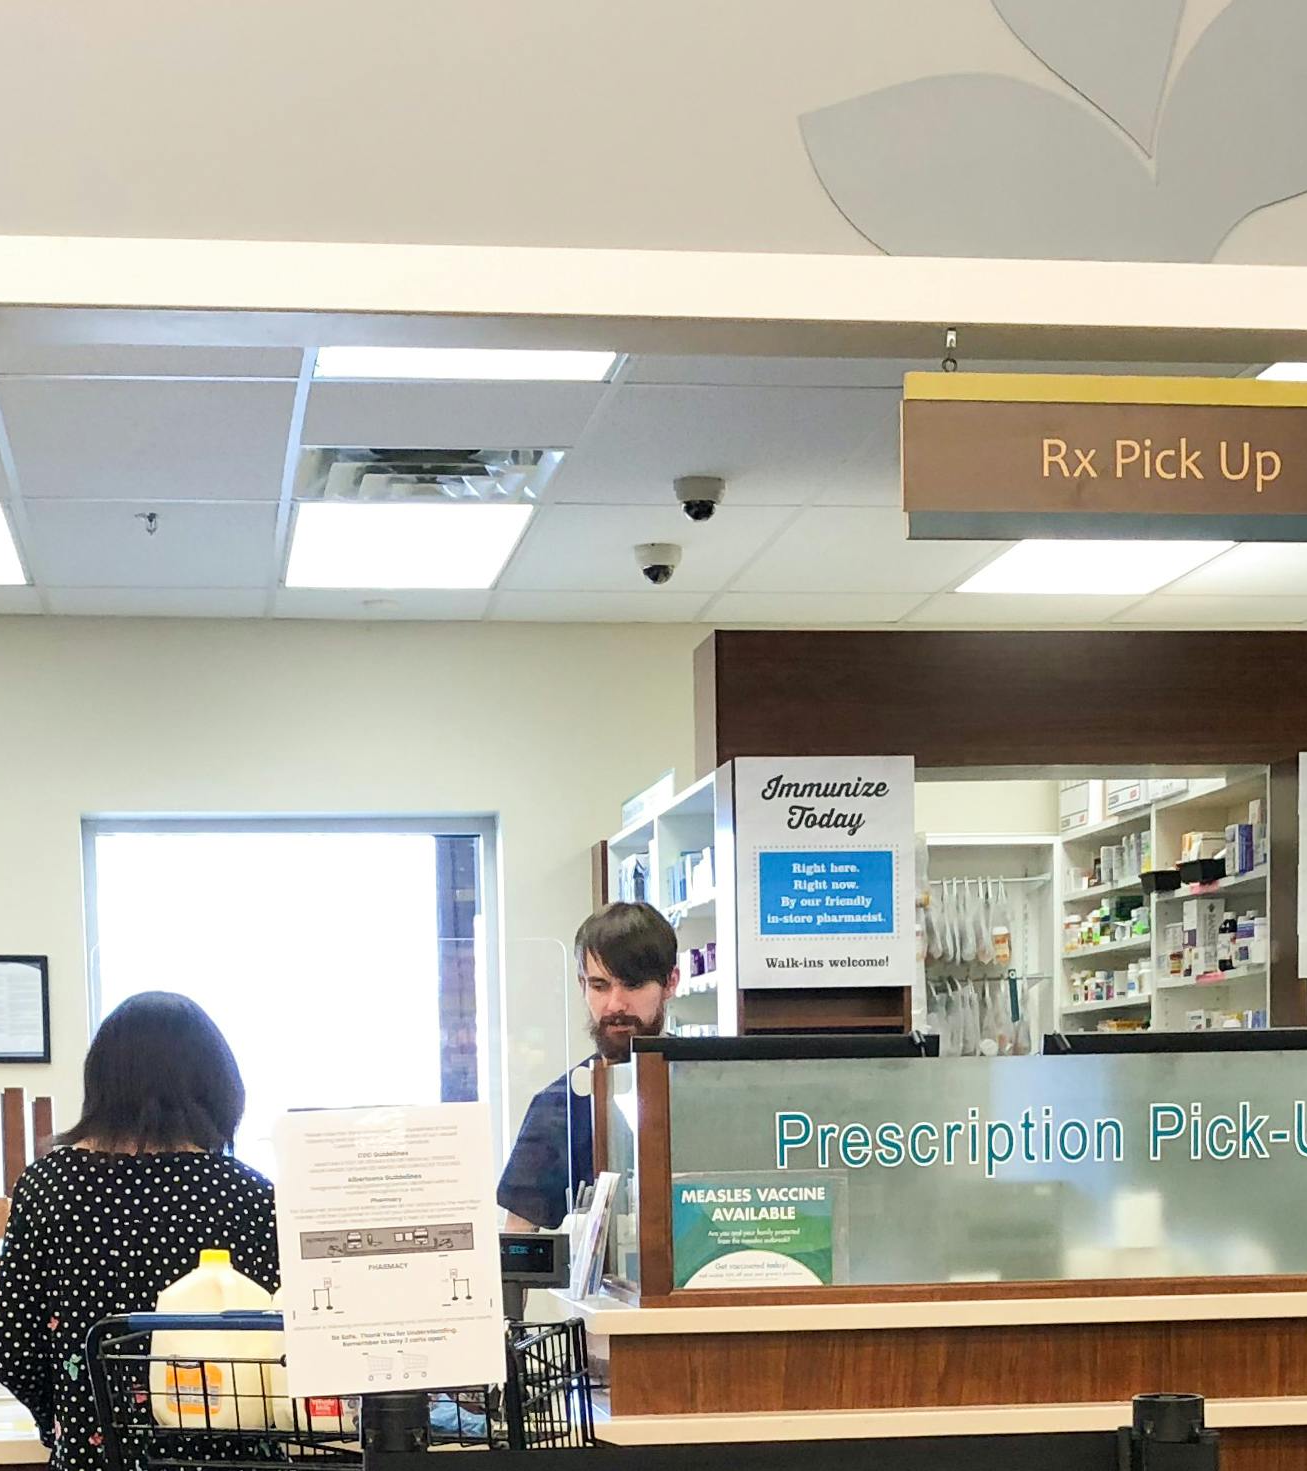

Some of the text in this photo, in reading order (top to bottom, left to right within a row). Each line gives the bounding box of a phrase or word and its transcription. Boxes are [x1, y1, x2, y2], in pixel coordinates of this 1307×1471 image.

[1042, 438, 1282, 493] Rx Pick Up
[761, 774, 890, 801] Immunize
[786, 805, 866, 836] Today
[792, 863, 860, 876] Right here.
[793, 880, 859, 892] Right now.
[781, 895, 873, 909] By our friendly
[767, 912, 886, 925] in-store pharmacist.
[765, 955, 890, 969] Walk-ins welcome!
[775, 1106, 1124, 1178] Prescription
[681, 1187, 826, 1204] MEASLES VACCINE
[711, 1206, 797, 1222] AVAILABLE
